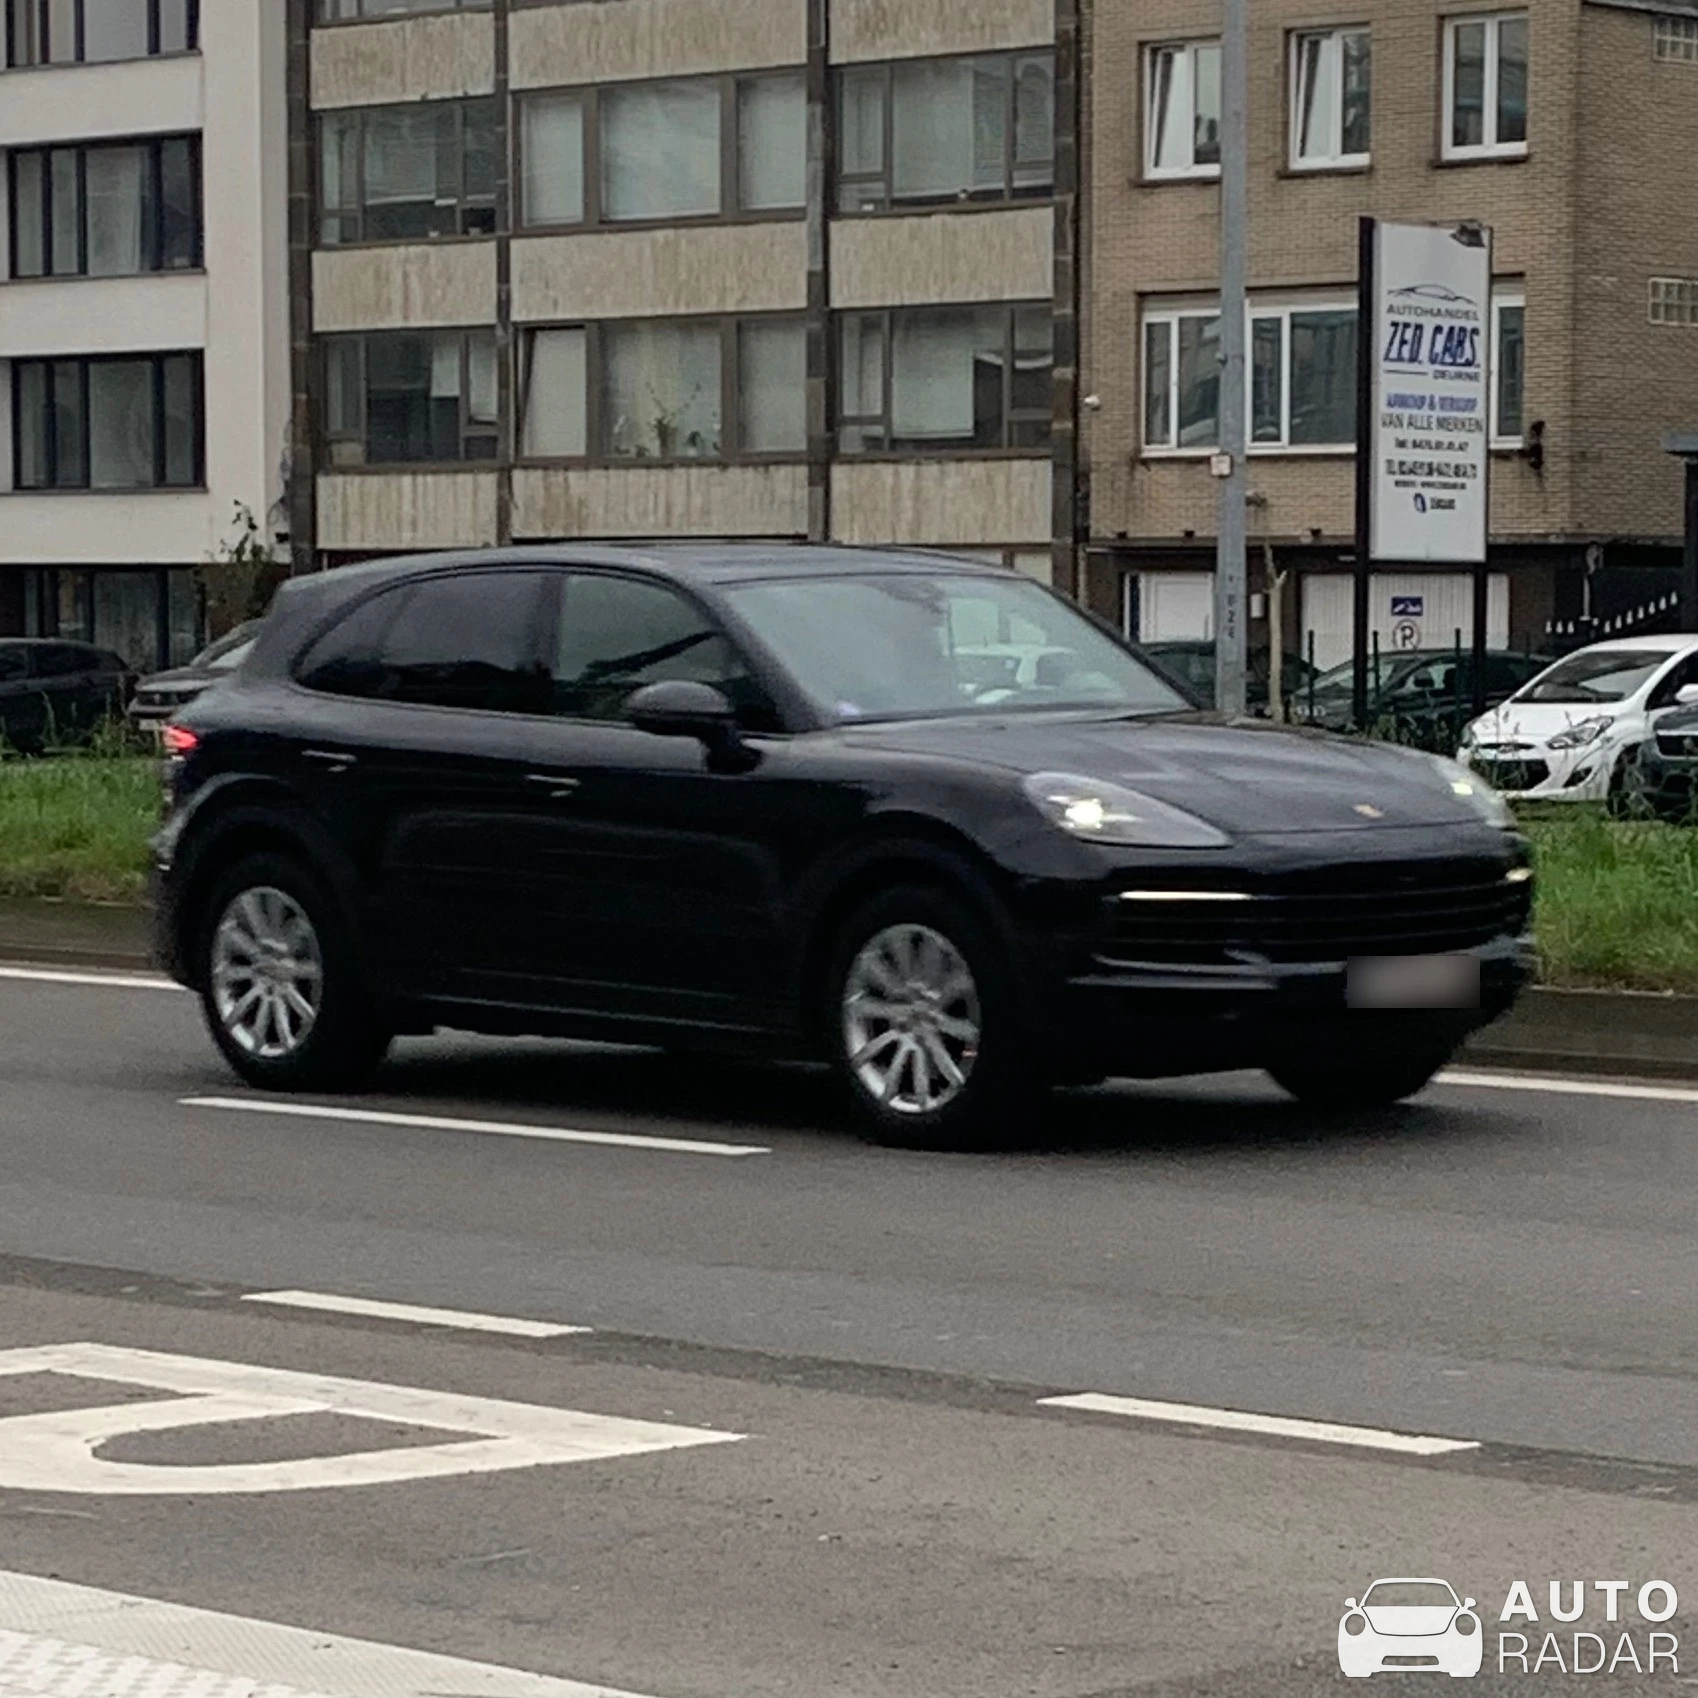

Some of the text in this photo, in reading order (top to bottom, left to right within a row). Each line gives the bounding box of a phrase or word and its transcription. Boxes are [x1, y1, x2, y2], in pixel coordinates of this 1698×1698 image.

[1387, 304, 1480, 321] AUTOHANDEL
[1407, 414, 1433, 430] ALLE
[1401, 625, 1414, 648] P
